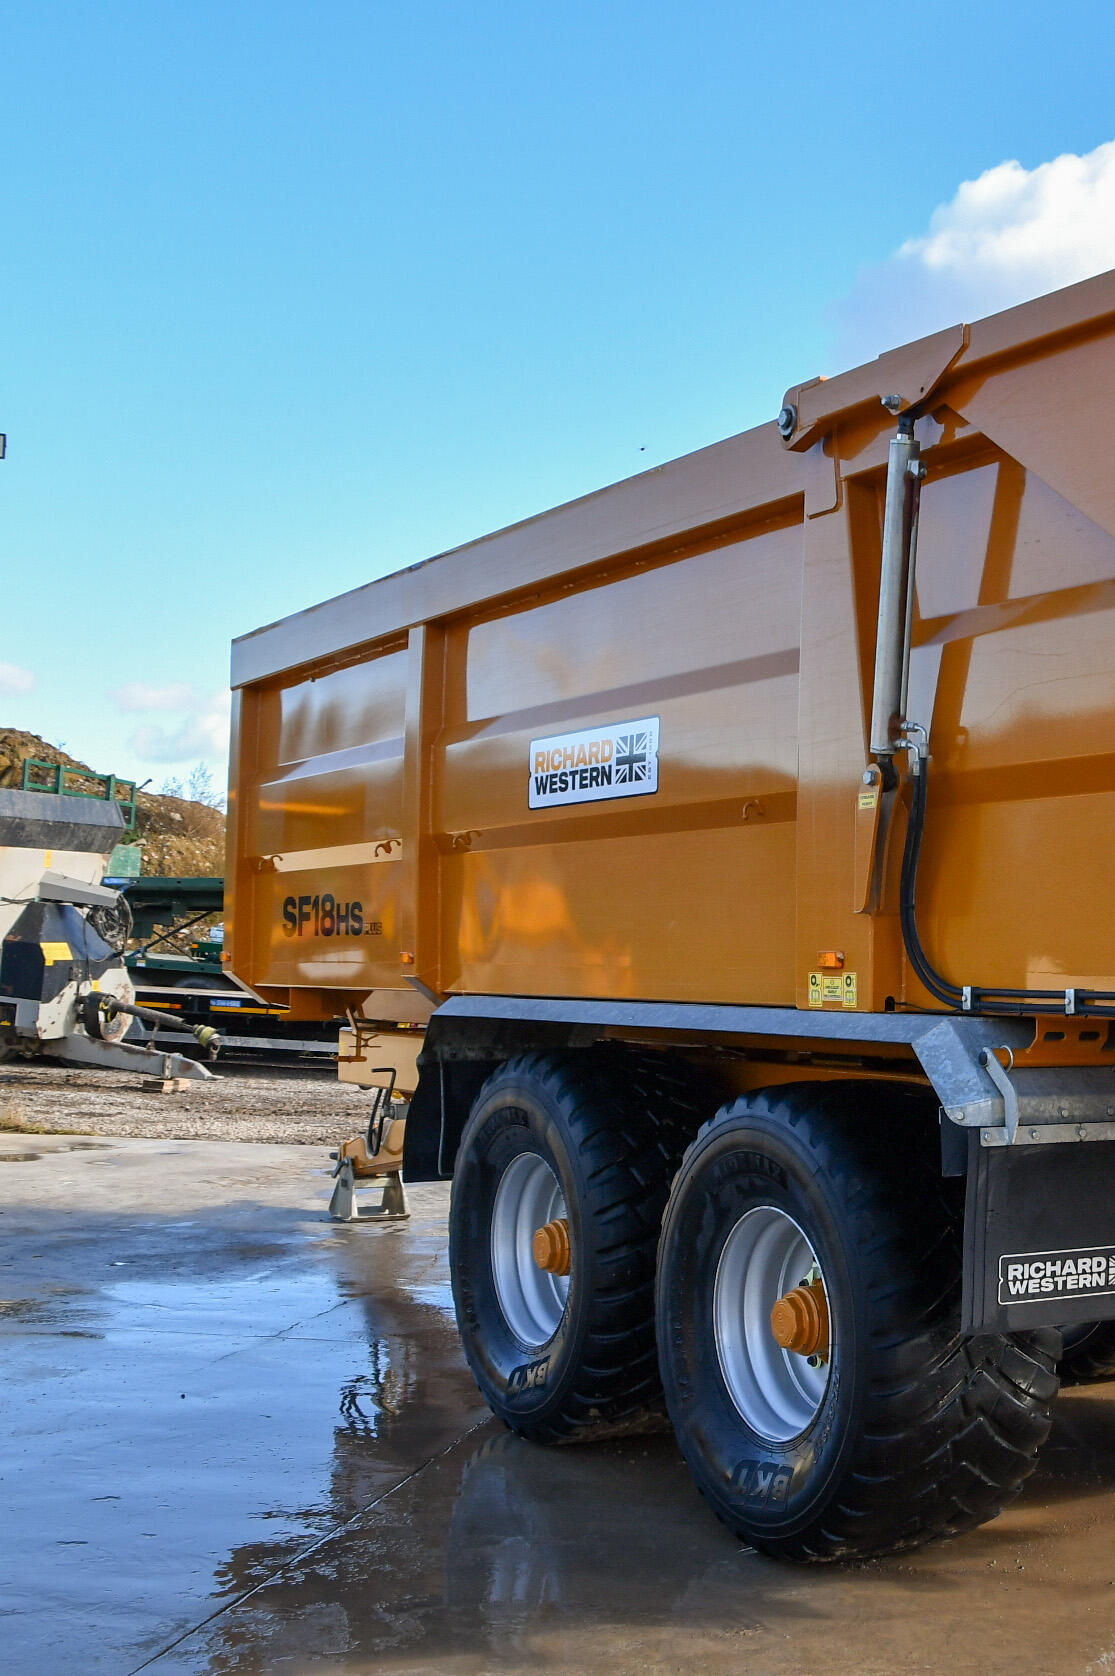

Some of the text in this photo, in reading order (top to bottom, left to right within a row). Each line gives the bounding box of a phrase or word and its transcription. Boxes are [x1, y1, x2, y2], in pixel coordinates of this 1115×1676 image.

[535, 739, 613, 773] RICHARD
[535, 765, 612, 795] WESTERN
[282, 894, 363, 937] SF18HS
[1008, 1256, 1107, 1281] RICHARD
[1008, 1273, 1106, 1295] WESTERN
